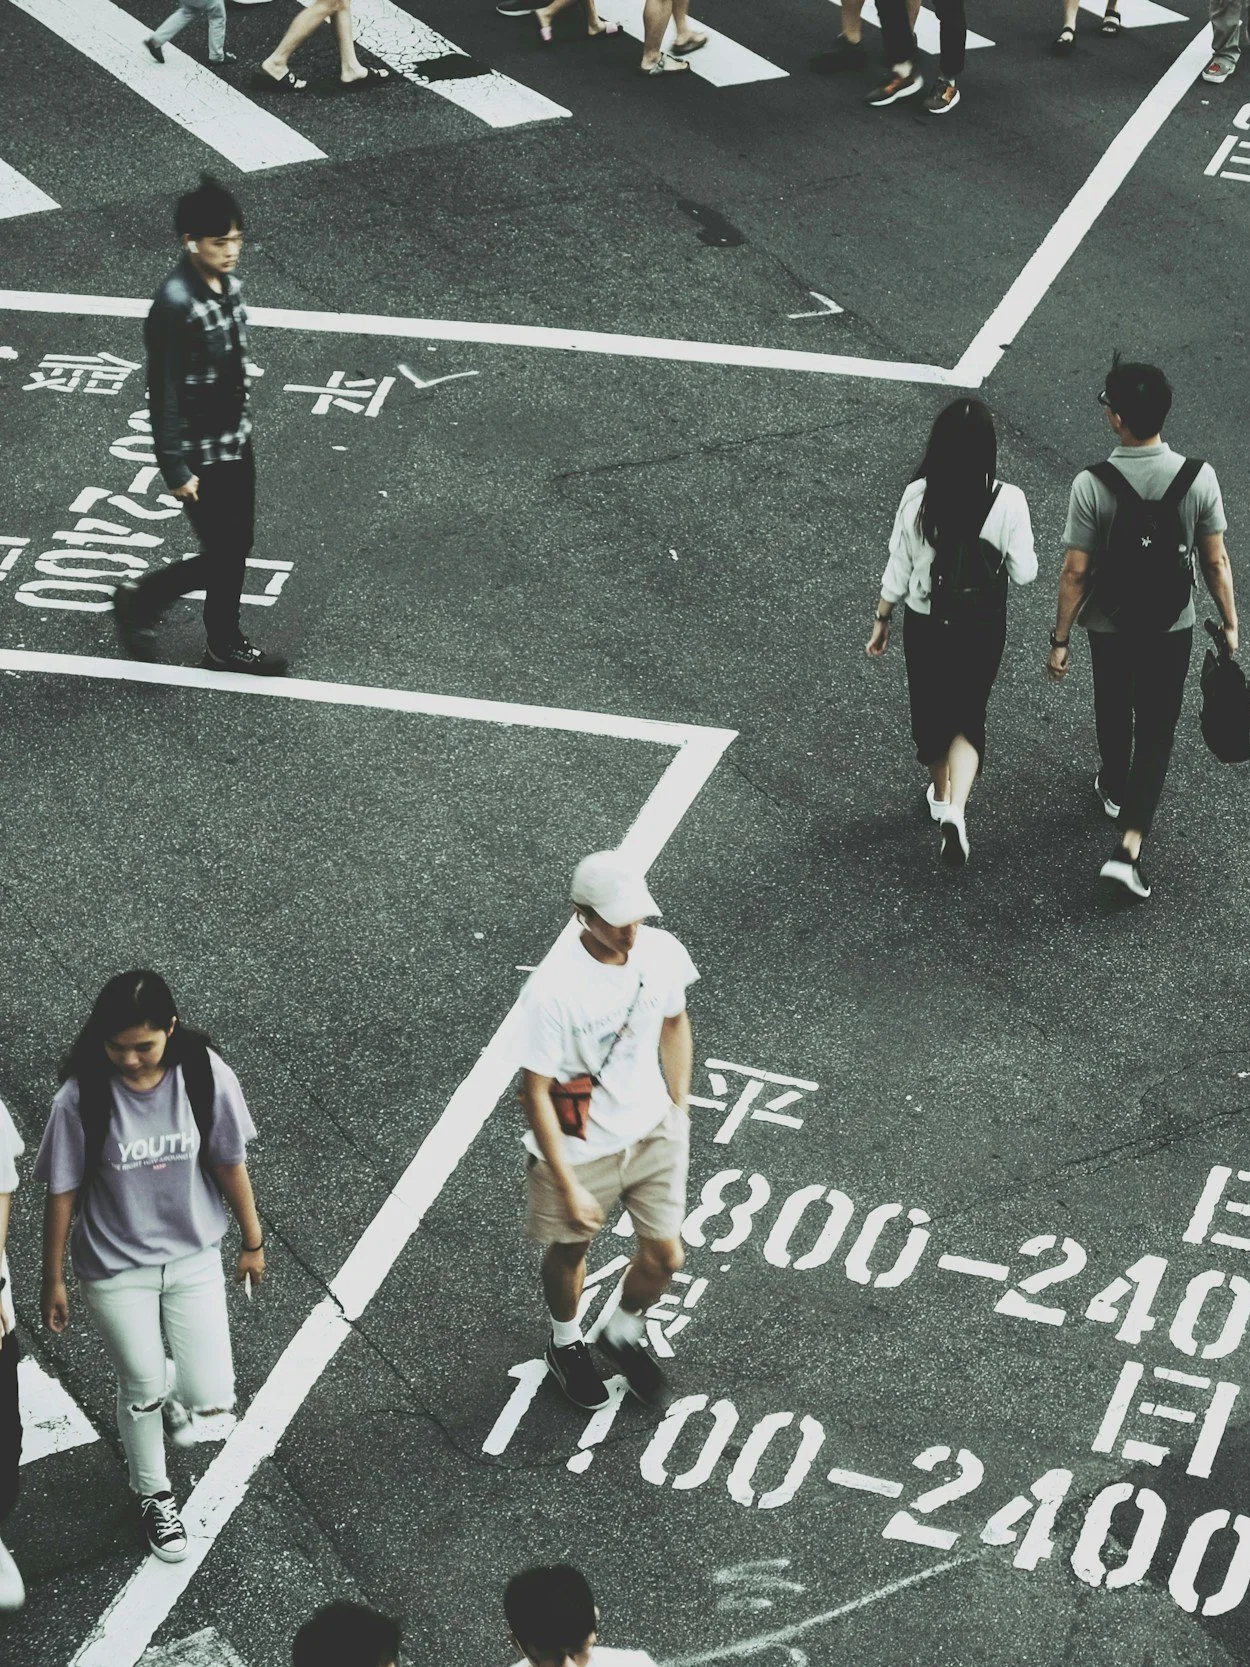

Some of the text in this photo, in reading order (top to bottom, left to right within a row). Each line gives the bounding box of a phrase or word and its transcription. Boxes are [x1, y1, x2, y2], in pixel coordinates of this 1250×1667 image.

[685, 1057, 820, 1145] 平
[117, 1129, 196, 1163] YOUTH
[1091, 1360, 1240, 1478] 日
